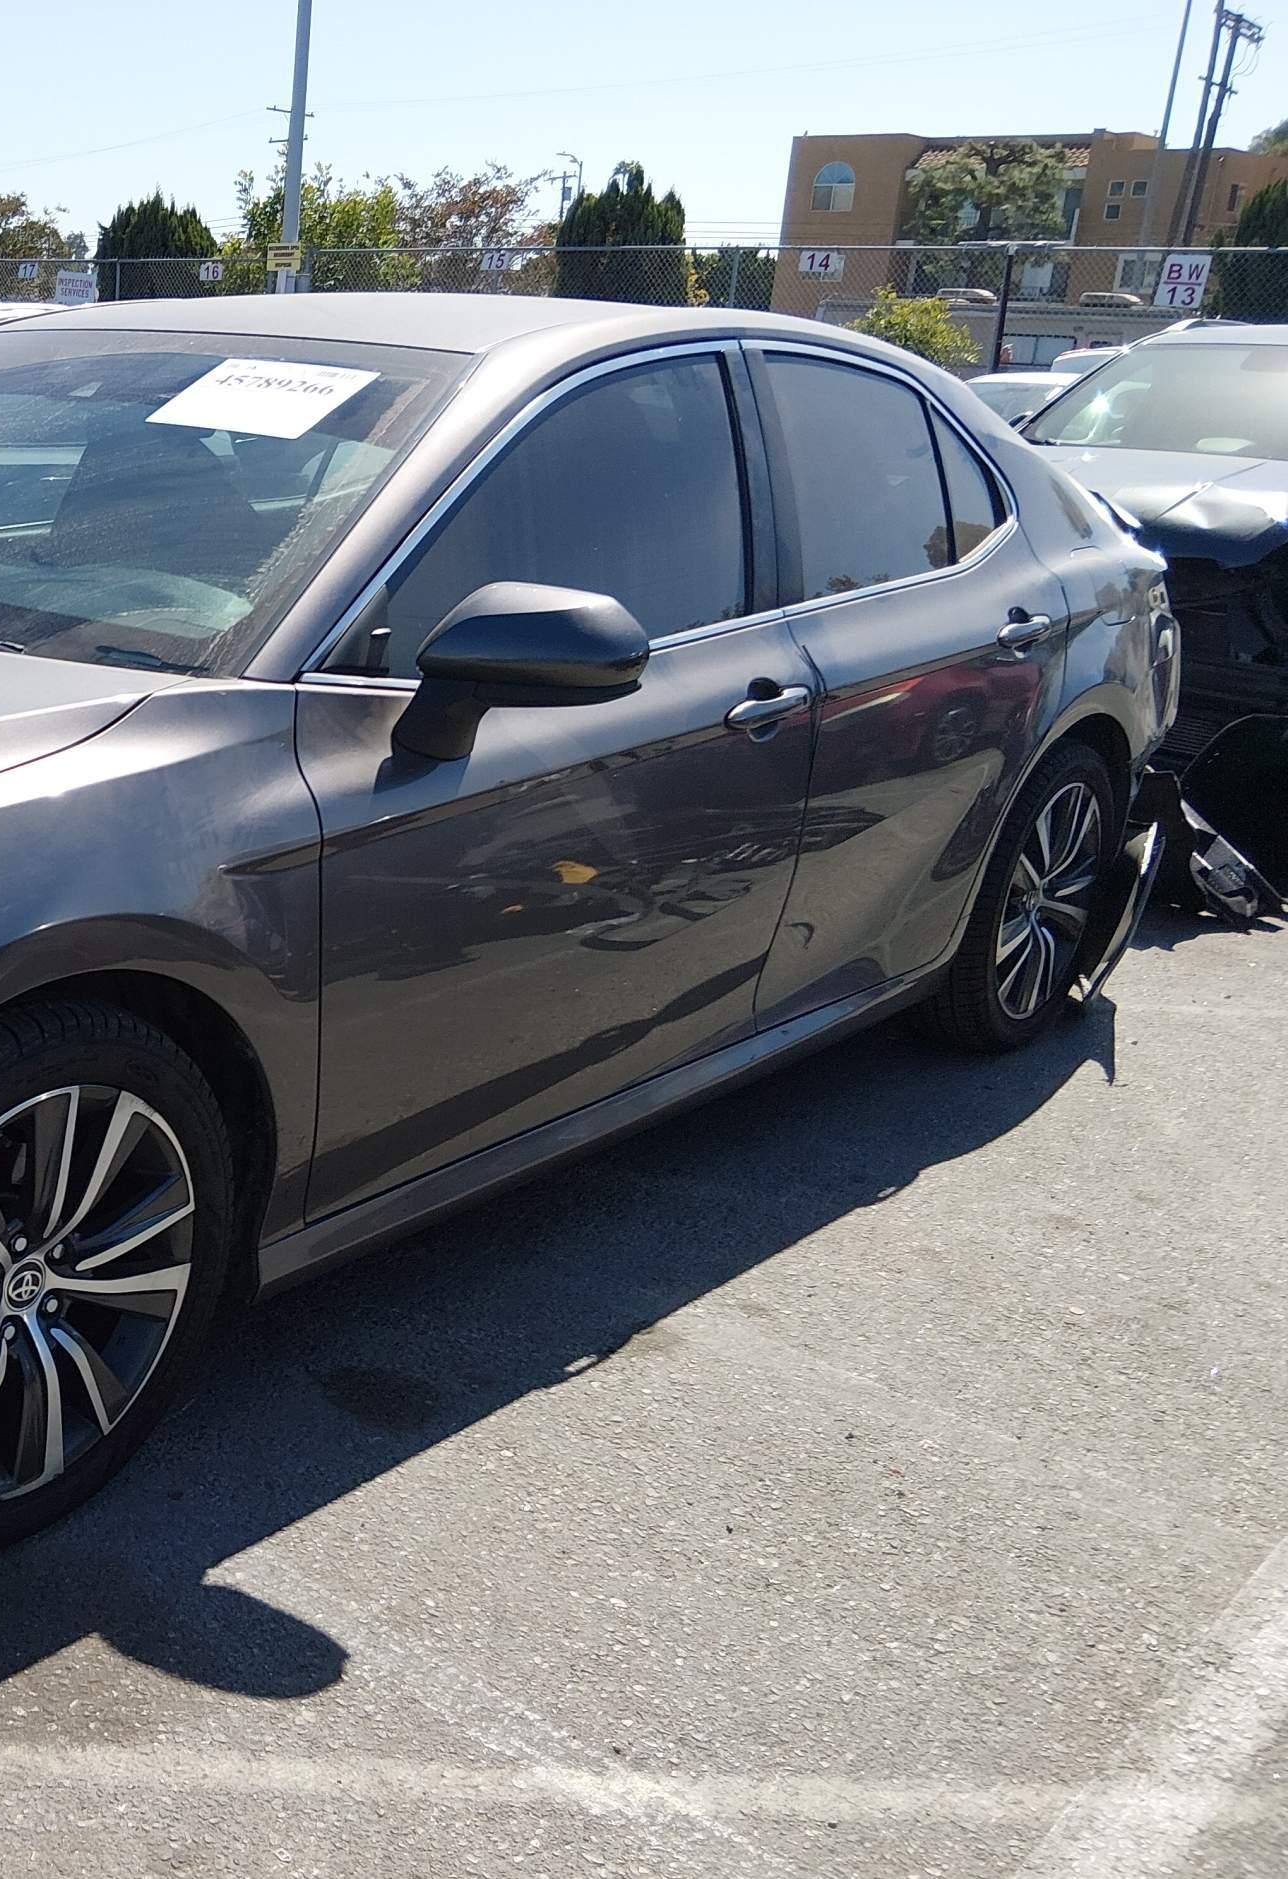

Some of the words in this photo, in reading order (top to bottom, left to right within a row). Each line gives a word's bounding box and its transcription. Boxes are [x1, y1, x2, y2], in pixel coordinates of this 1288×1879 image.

[487, 253, 505, 269] 15
[807, 252, 830, 271] 14
[23, 264, 36, 277] 17
[204, 265, 219, 280] 16
[58, 278, 93, 289] INSPECTION
[61, 288, 89, 298] SERVICES
[1167, 286, 1196, 306] 13
[215, 373, 335, 397] 45789266
